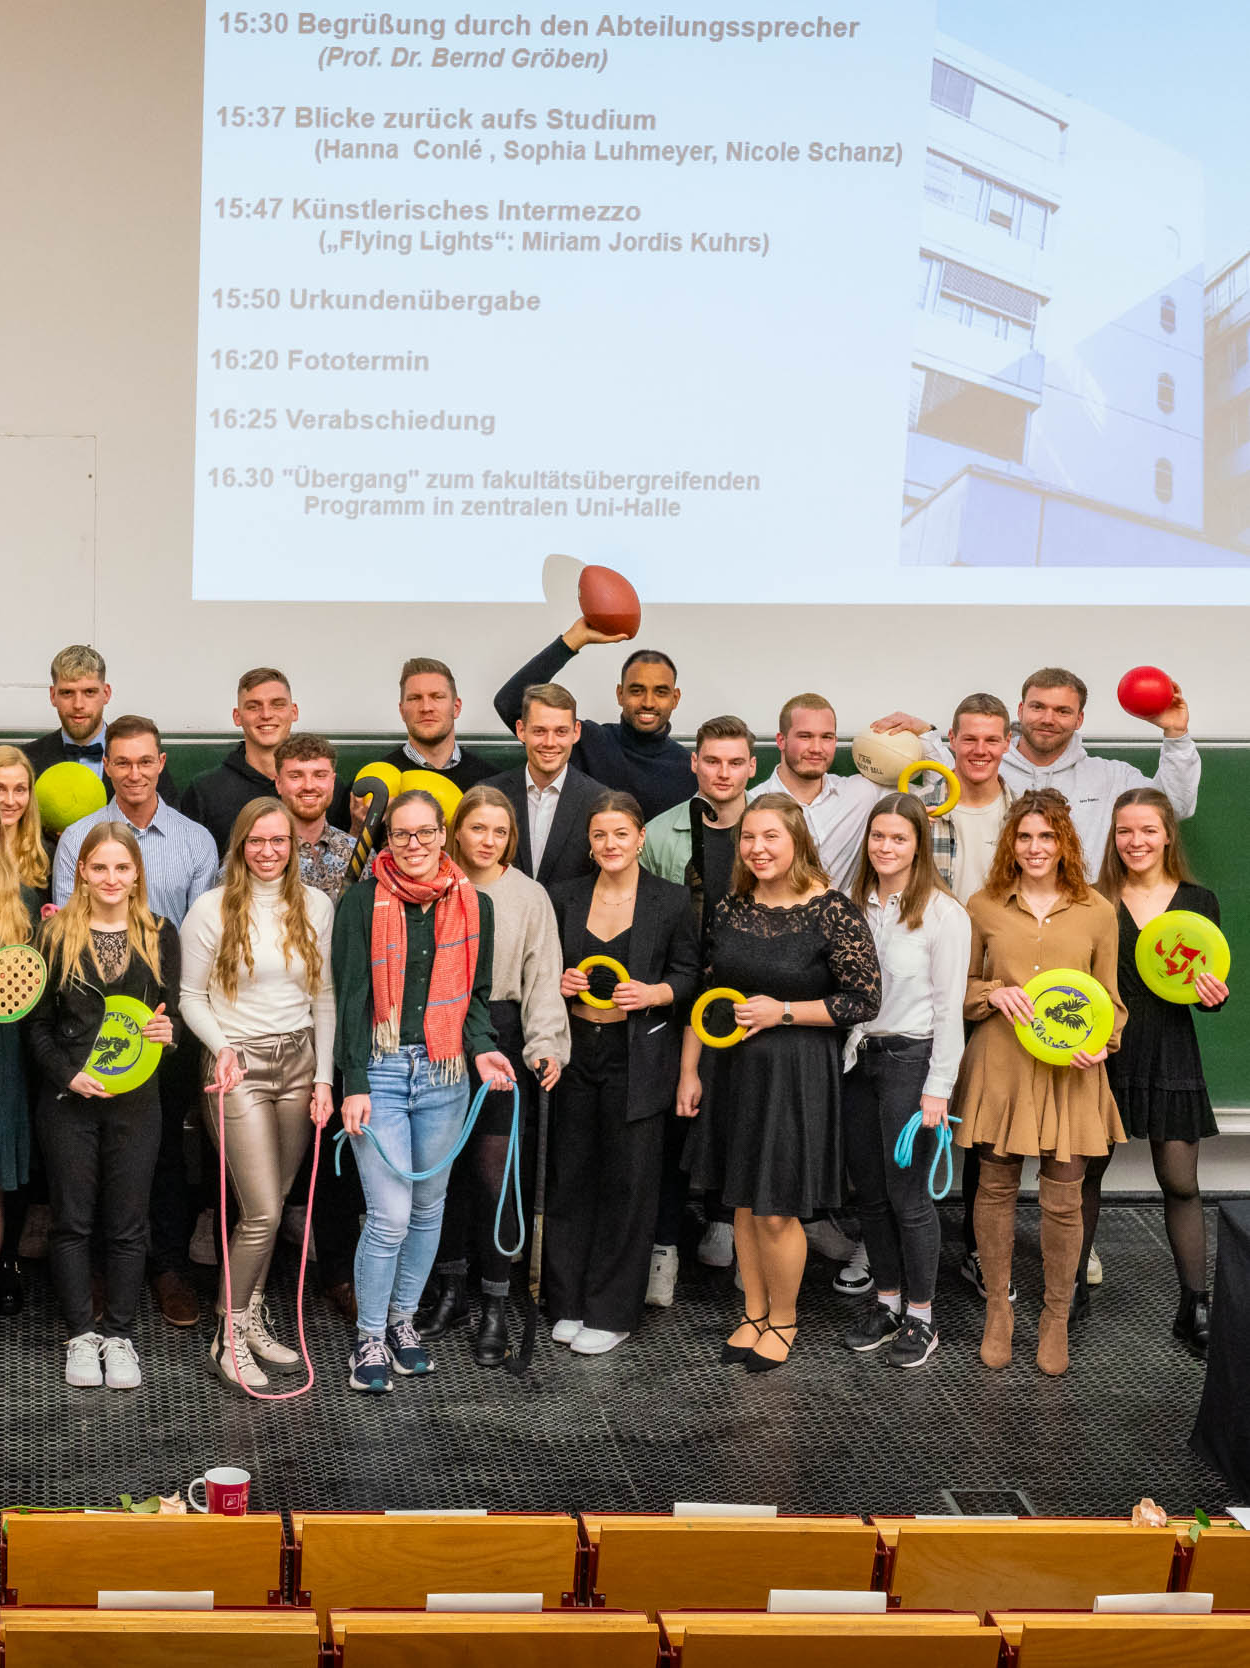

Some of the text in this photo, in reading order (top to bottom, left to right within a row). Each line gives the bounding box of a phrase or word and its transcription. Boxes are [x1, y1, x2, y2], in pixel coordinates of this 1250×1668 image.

[218, 11, 862, 44] 15:30 Begrüßung durch den Abteilungssprecher
[317, 45, 609, 75] (Prof. Dr. Bernd Gröben)
[216, 105, 657, 131] 15:37 Blicke zurück aufs Studium
[314, 137, 399, 165] (Hanna
[413, 137, 483, 161] Conlé
[503, 139, 587, 166] Sophia
[593, 140, 718, 168] Luhmeyer,
[725, 140, 801, 163] Nicole
[806, 140, 903, 168] Schanz)
[214, 196, 642, 222] 15:47 Künstlerisches Intermezzo
[521, 231, 602, 253] Miriam
[607, 231, 684, 253] Jordis
[689, 231, 770, 259] Kuhrs)
[211, 287, 541, 317] 15:50 Urkundenübergabe
[210, 348, 430, 372] 16:20 Fototermin
[209, 407, 496, 437] 16:25 Verabschiedung
[207, 466, 275, 489] 16.30
[425, 472, 475, 489] zum
[481, 469, 761, 496] fakultätsübergreifenden
[304, 495, 682, 521] Programm in zentralen Uni-Halle
